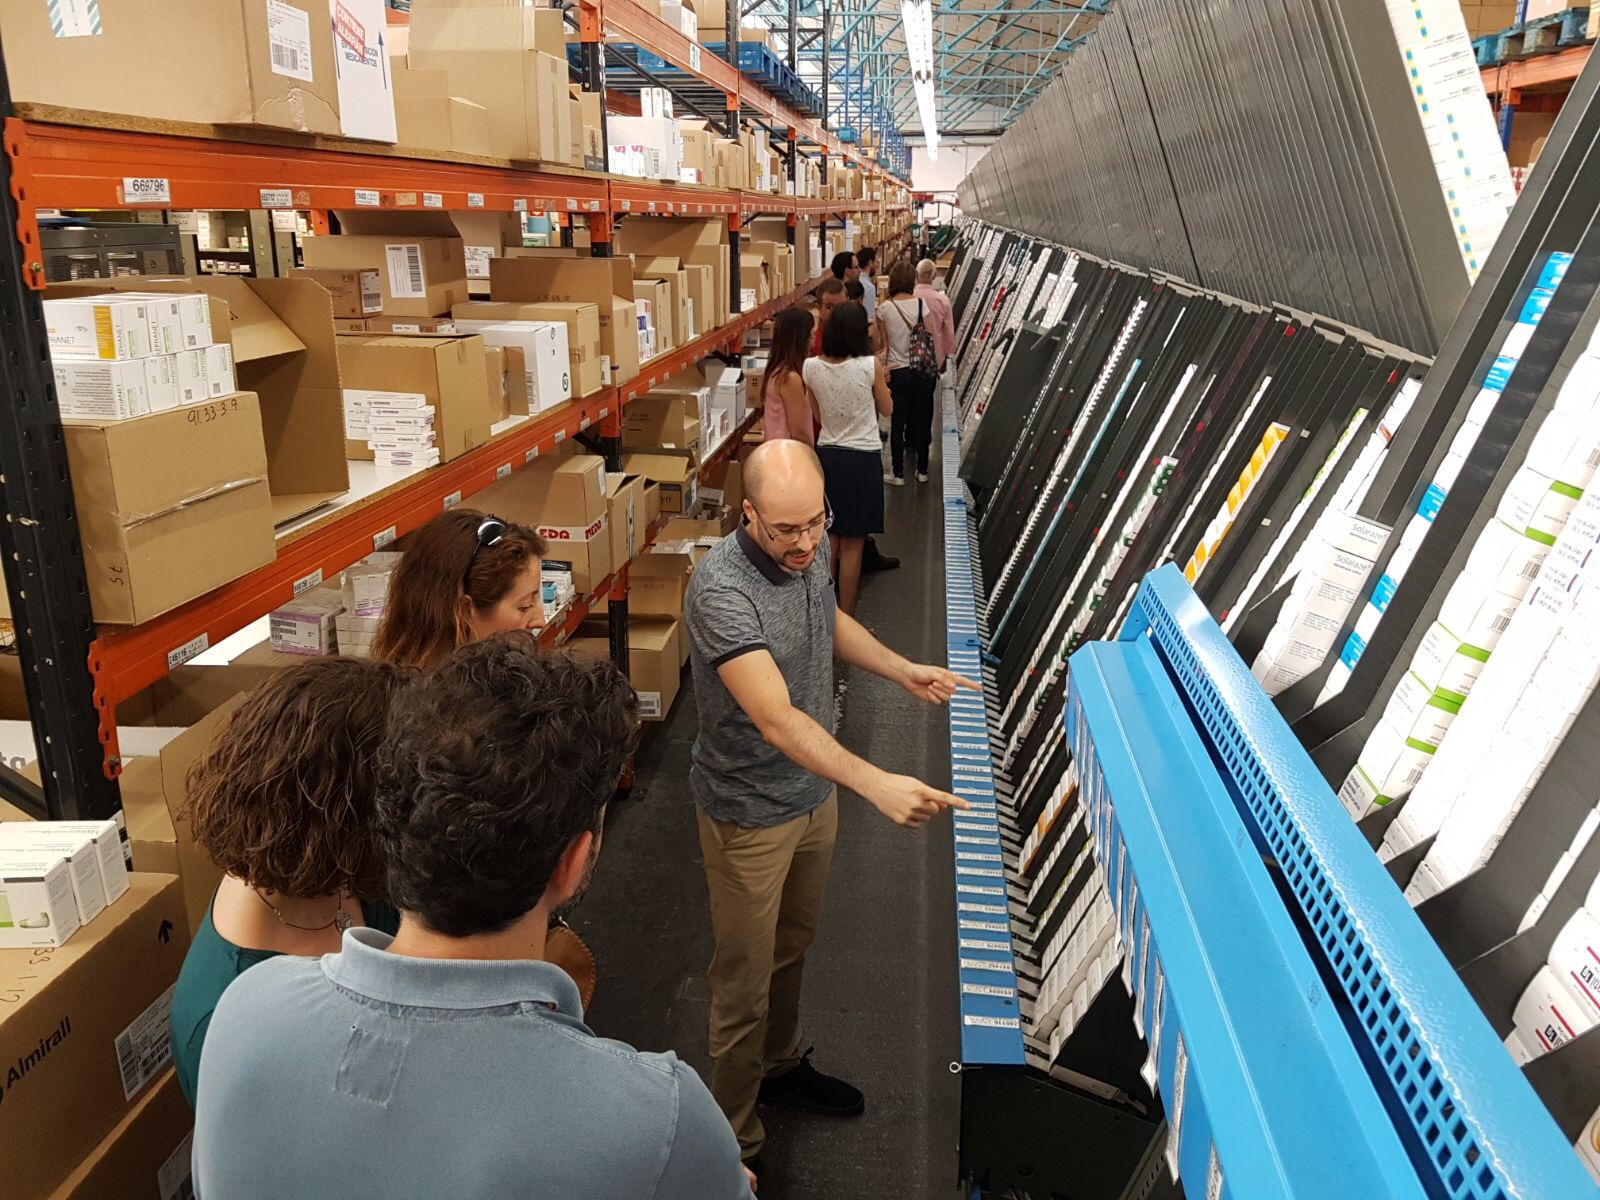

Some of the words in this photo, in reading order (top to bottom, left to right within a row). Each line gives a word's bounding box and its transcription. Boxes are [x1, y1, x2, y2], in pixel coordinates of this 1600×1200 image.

[132, 179, 165, 192] 669796
[539, 528, 570, 540] EDA
[6, 1015, 72, 1090] Almirall
